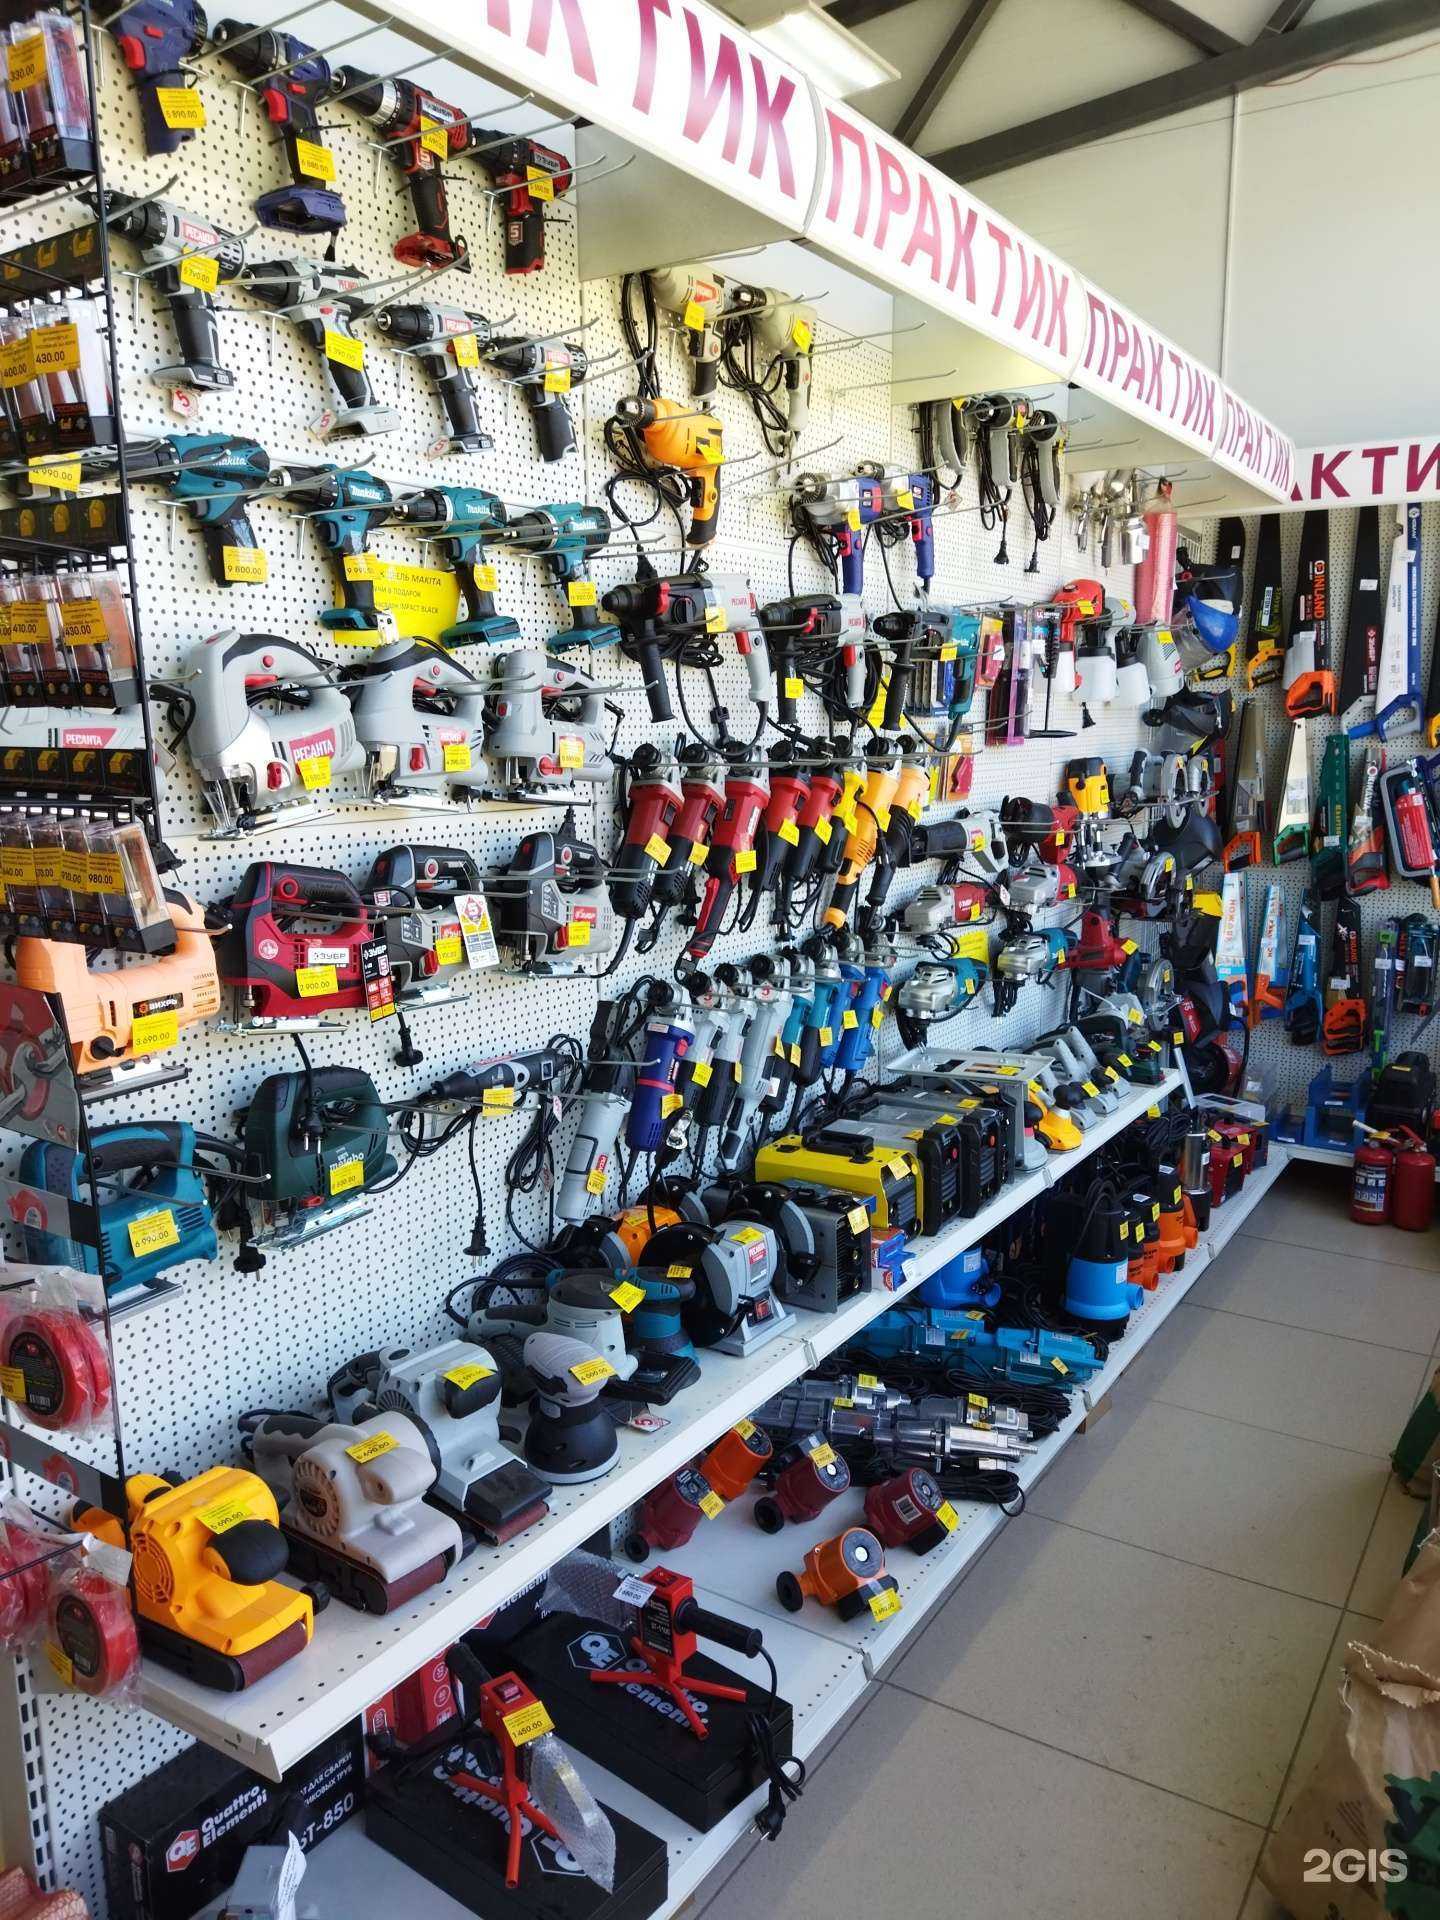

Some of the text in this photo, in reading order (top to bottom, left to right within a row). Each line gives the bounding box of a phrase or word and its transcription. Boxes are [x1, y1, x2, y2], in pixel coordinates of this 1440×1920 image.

[825, 107, 1070, 357] ПРАКТИК
[35, 350, 65, 364] 430.00
[1084, 291, 1216, 442] ПРАКТИК
[1221, 393, 1292, 492] ПРАКТИК
[65, 625, 91, 636] 430.00
[65, 734, 104, 746] РЕСАНТА
[87, 872, 114, 885] 980.00
[154, 998, 183, 1011] ВИХРЬ
[142, 1230, 169, 1244] 990.00
[322, 1750, 353, 1780] СВАРКИ
[201, 1785, 260, 1834] Quattro
[203, 1799, 267, 1849] Elementi
